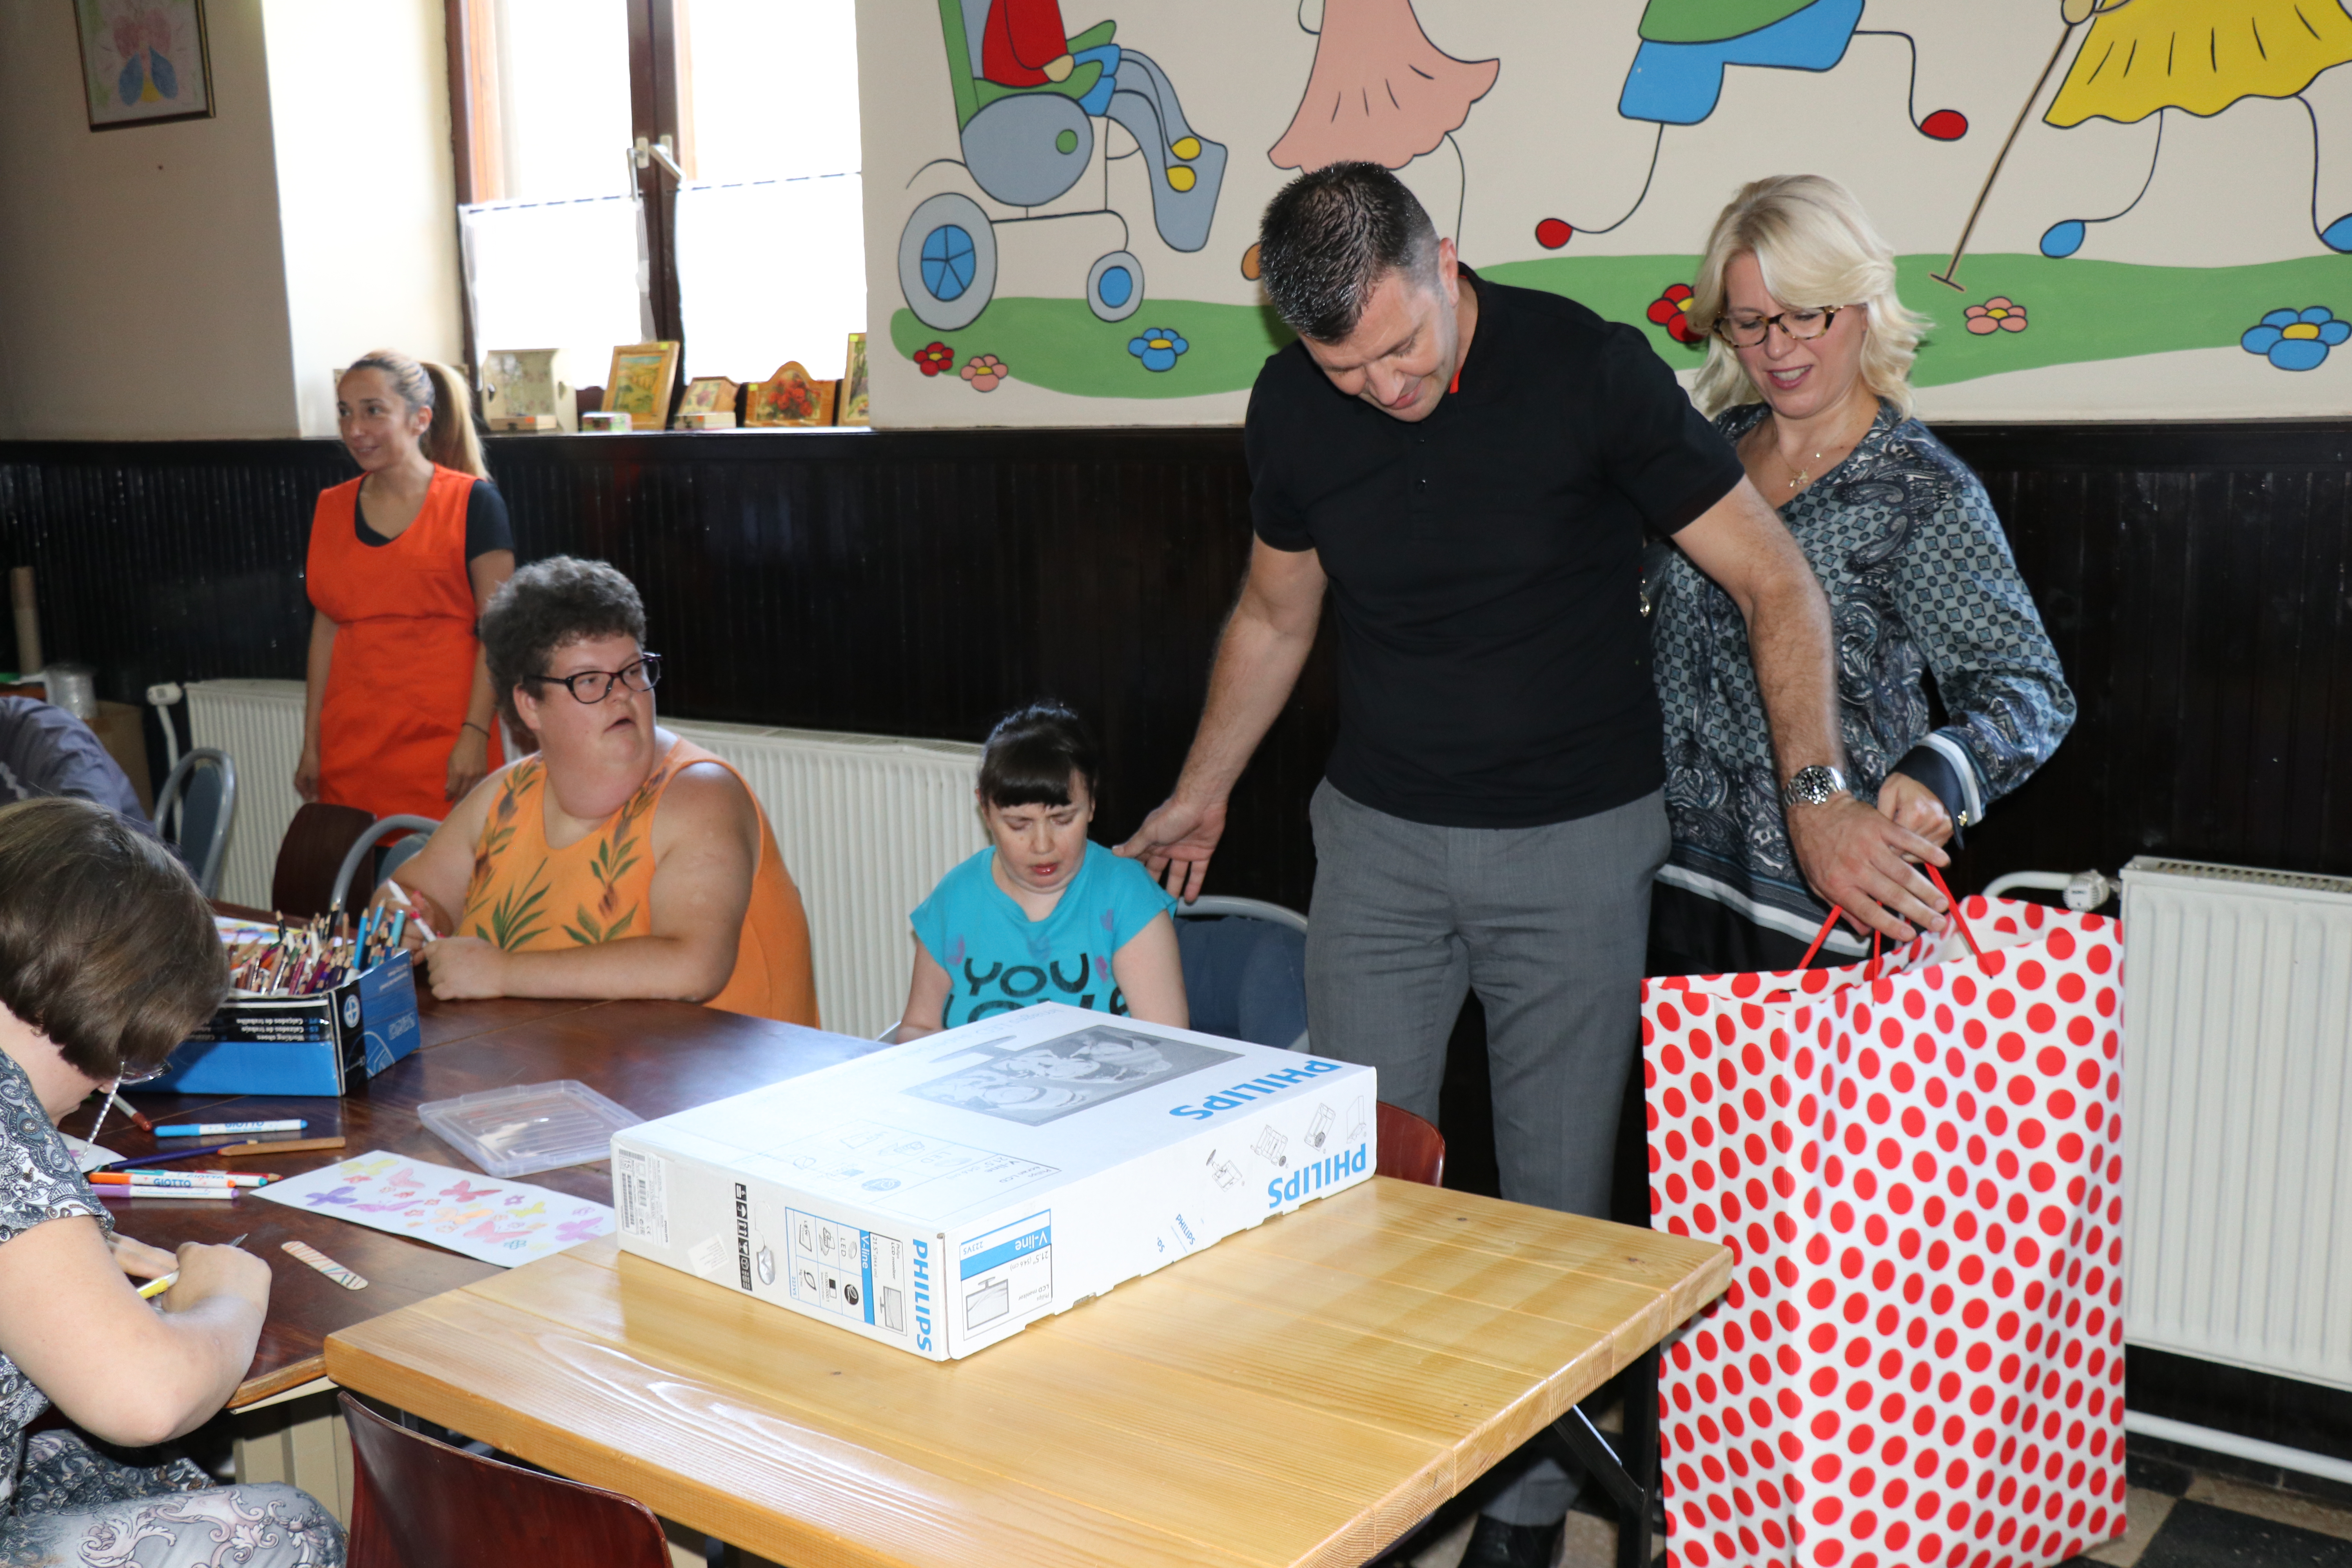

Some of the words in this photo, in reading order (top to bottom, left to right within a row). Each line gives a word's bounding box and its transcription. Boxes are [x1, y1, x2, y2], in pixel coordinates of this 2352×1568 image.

[964, 953, 1089, 998] YOU
[1169, 1060, 1343, 1120] PHILIPS
[623, 1159, 631, 1169] 15
[919, 1151, 953, 1164] LED
[983, 1160, 1020, 1173] V-line
[154, 1178, 191, 1187] GIOTTO
[1268, 1143, 1366, 1209] PHILIPS
[1176, 1213, 1195, 1245] PHILIPS
[1014, 1230, 1048, 1251] V-line
[861, 1235, 869, 1269] V-line
[963, 1241, 984, 1255] 223V5
[1020, 1256, 1032, 1268] (54.6
[1033, 1250, 1049, 1265] 21.5"
[1010, 1263, 1019, 1272] cm)
[1018, 1289, 1038, 1301] monitor
[1038, 1284, 1049, 1293] LCD
[913, 1239, 932, 1352] PHILIPS
[1036, 1292, 1049, 1301] Philips
